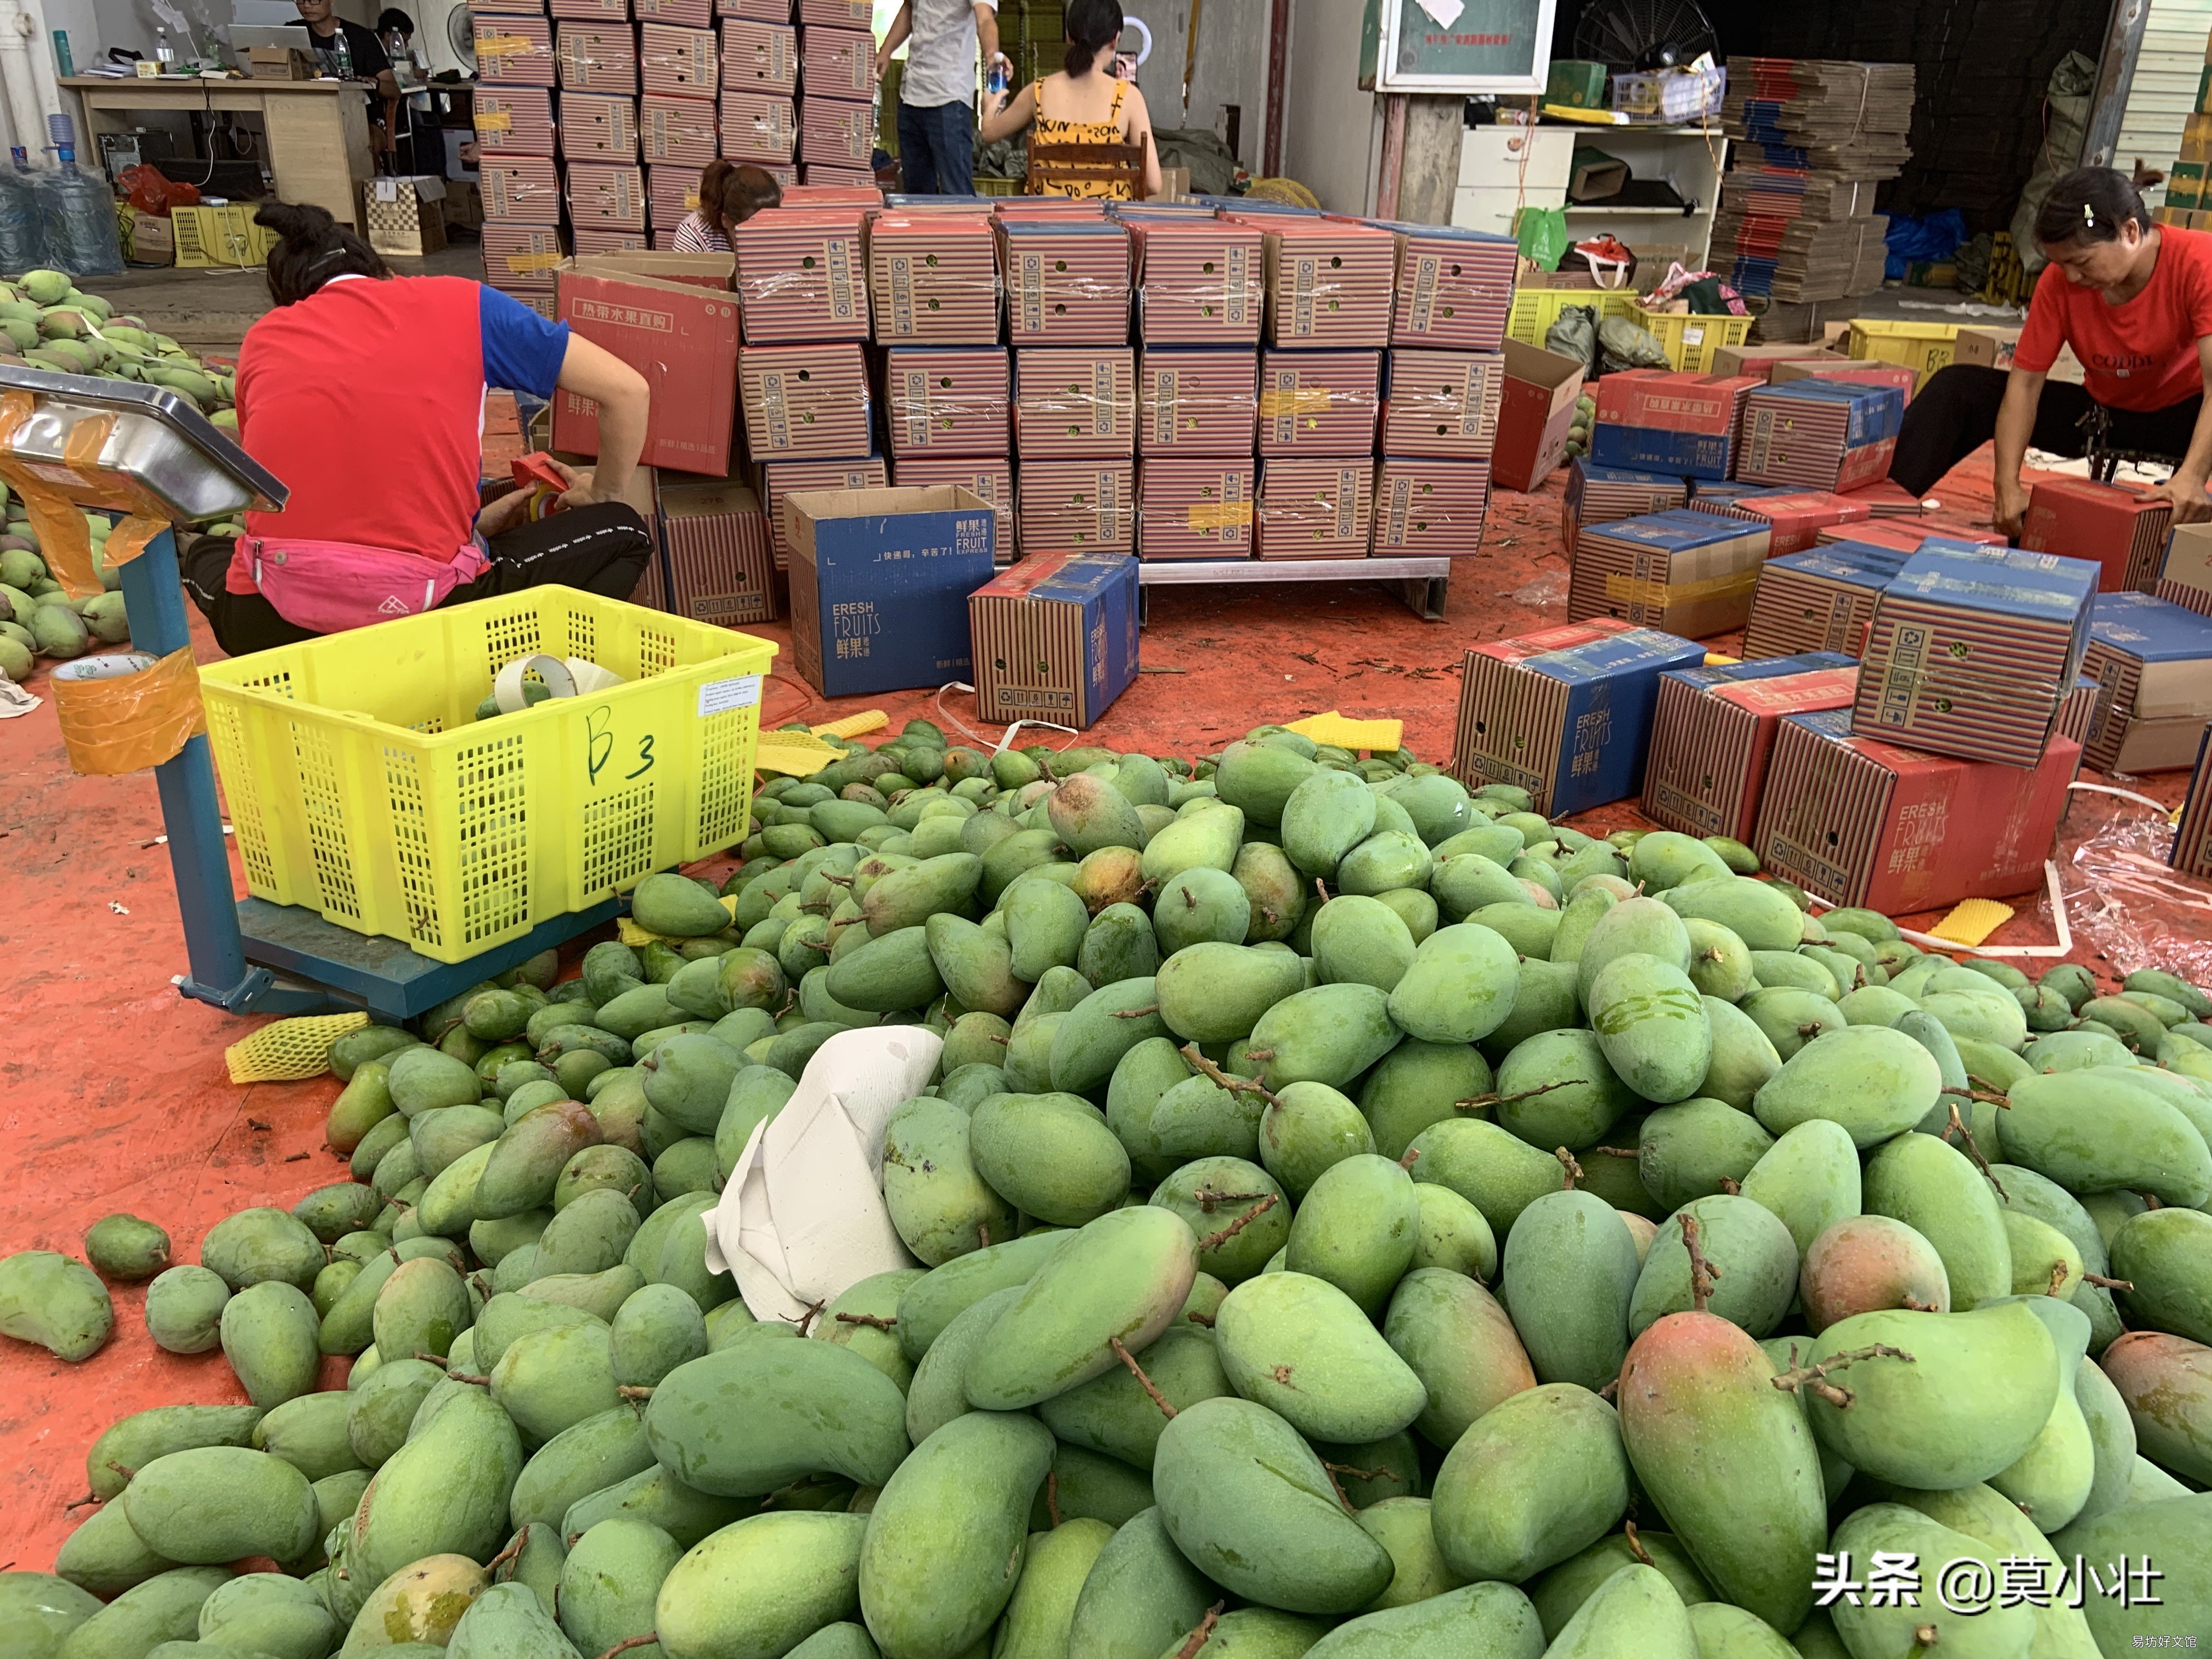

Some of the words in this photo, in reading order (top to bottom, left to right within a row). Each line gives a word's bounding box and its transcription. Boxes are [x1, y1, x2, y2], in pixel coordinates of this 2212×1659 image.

[582, 302, 667, 329] 热带水果直购
[956, 537, 987, 550] FRUIT
[833, 613, 881, 638] FRUITS
[836, 637, 863, 659] 鲜果
[1887, 847, 1918, 874] 鲜果
